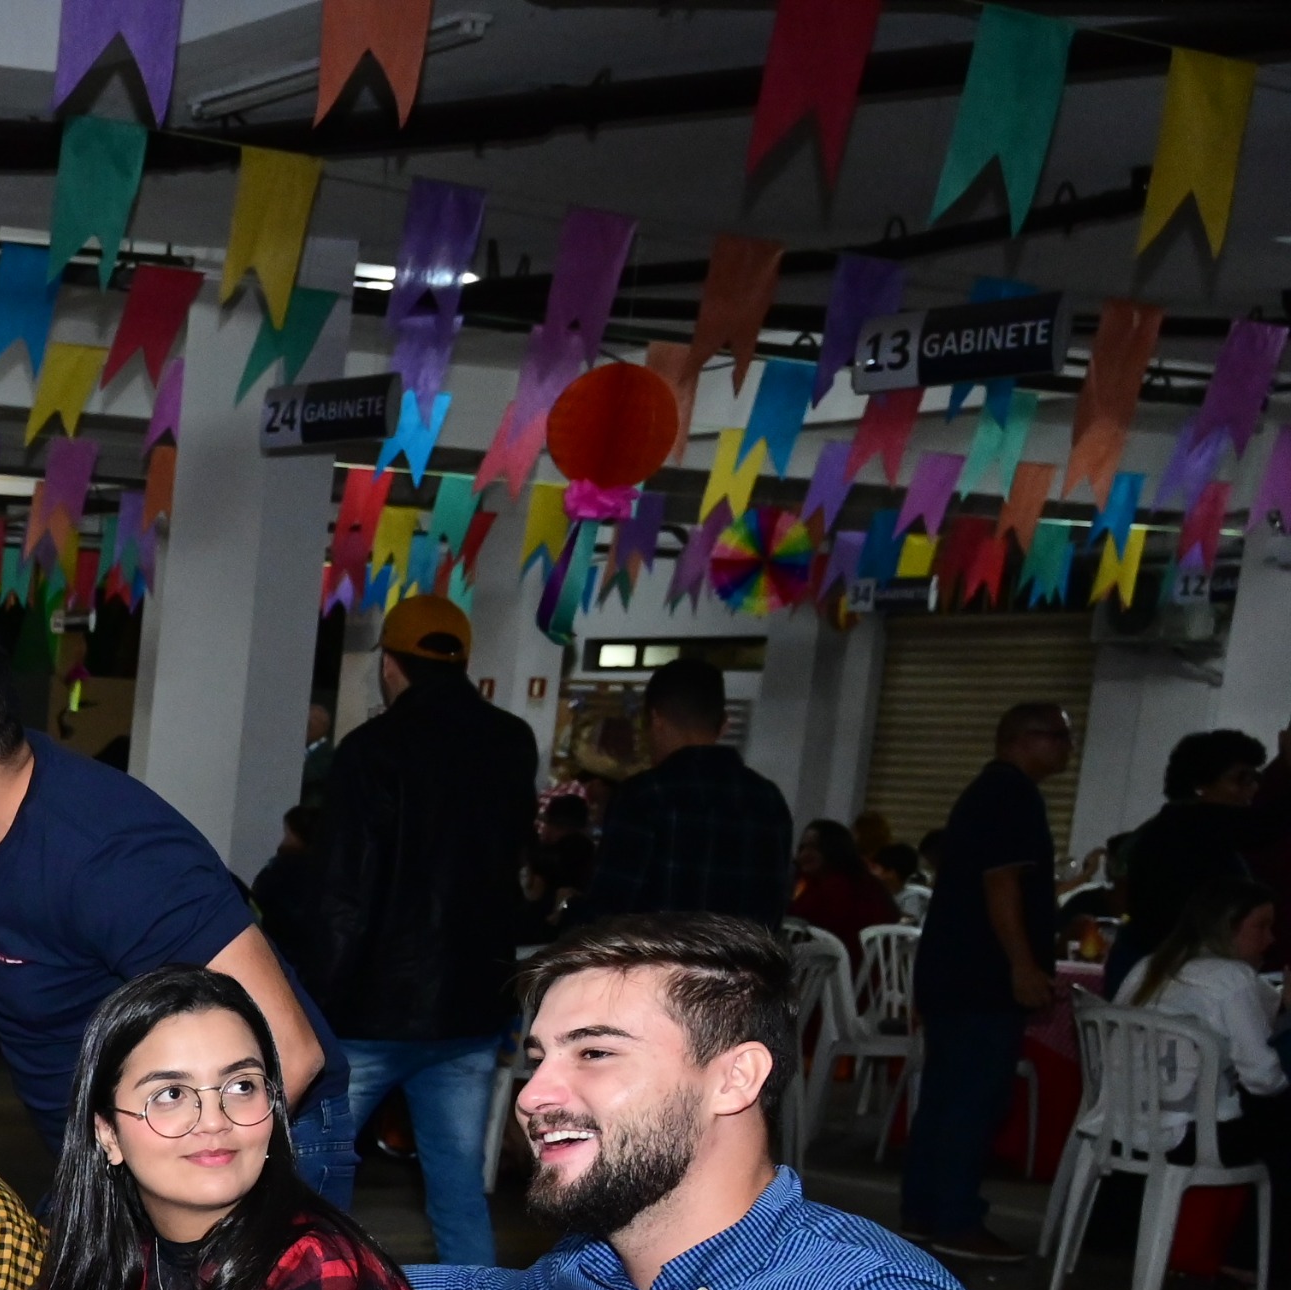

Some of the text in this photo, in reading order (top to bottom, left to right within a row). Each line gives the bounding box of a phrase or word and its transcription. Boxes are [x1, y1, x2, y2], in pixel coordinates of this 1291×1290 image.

[863, 318, 1051, 373] 13 GABINETE
[265, 395, 386, 433] 24 GABINETE
[1179, 575, 1205, 596] 12
